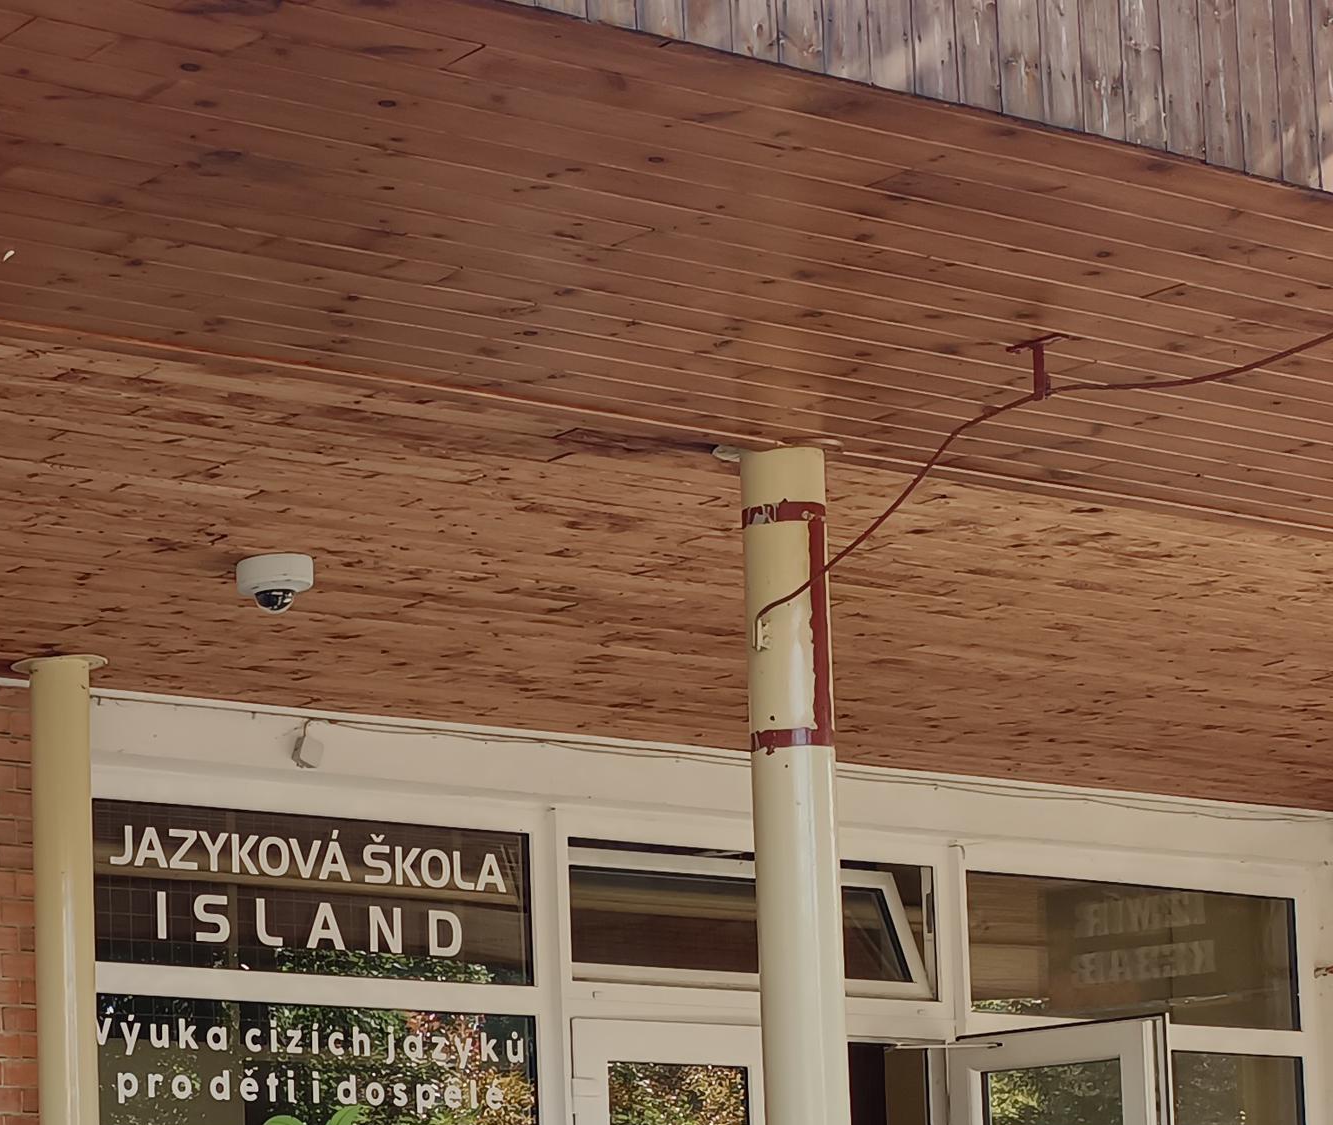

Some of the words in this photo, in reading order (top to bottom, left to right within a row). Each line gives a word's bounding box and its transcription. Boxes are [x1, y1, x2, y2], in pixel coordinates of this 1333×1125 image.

[110, 825, 352, 882] JAZYKOVÁ
[362, 833, 507, 893] ŠKOLA
[156, 891, 463, 958] ISLAND
[96, 1014, 228, 1056] Výuka
[385, 1025, 525, 1069] jazyků
[117, 1071, 193, 1104] pro
[209, 1067, 297, 1104] děti
[311, 1071, 321, 1104] i
